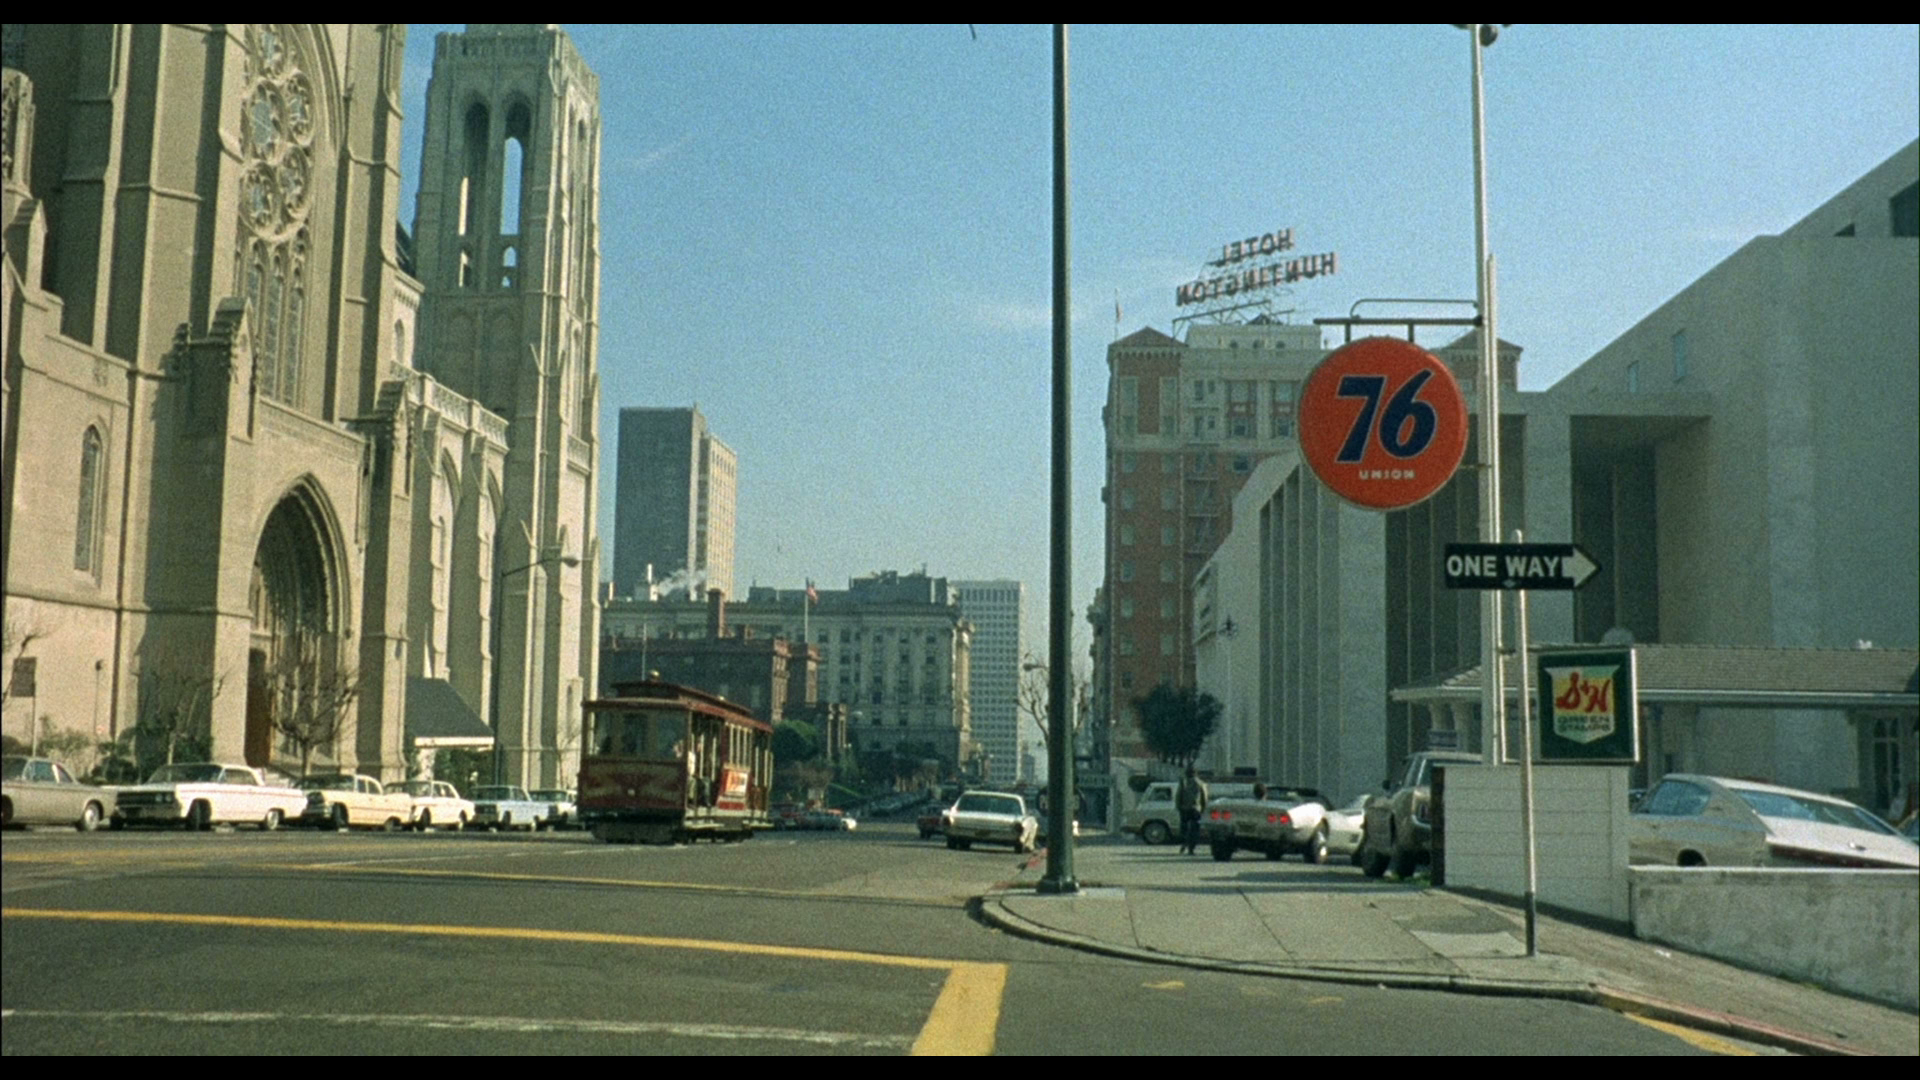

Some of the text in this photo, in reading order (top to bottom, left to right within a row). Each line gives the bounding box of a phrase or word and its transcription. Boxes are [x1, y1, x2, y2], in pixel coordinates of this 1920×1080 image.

[1335, 368, 1436, 463] 76
[1358, 470, 1416, 481] UNION
[1447, 556, 1559, 577] ONE WAY
